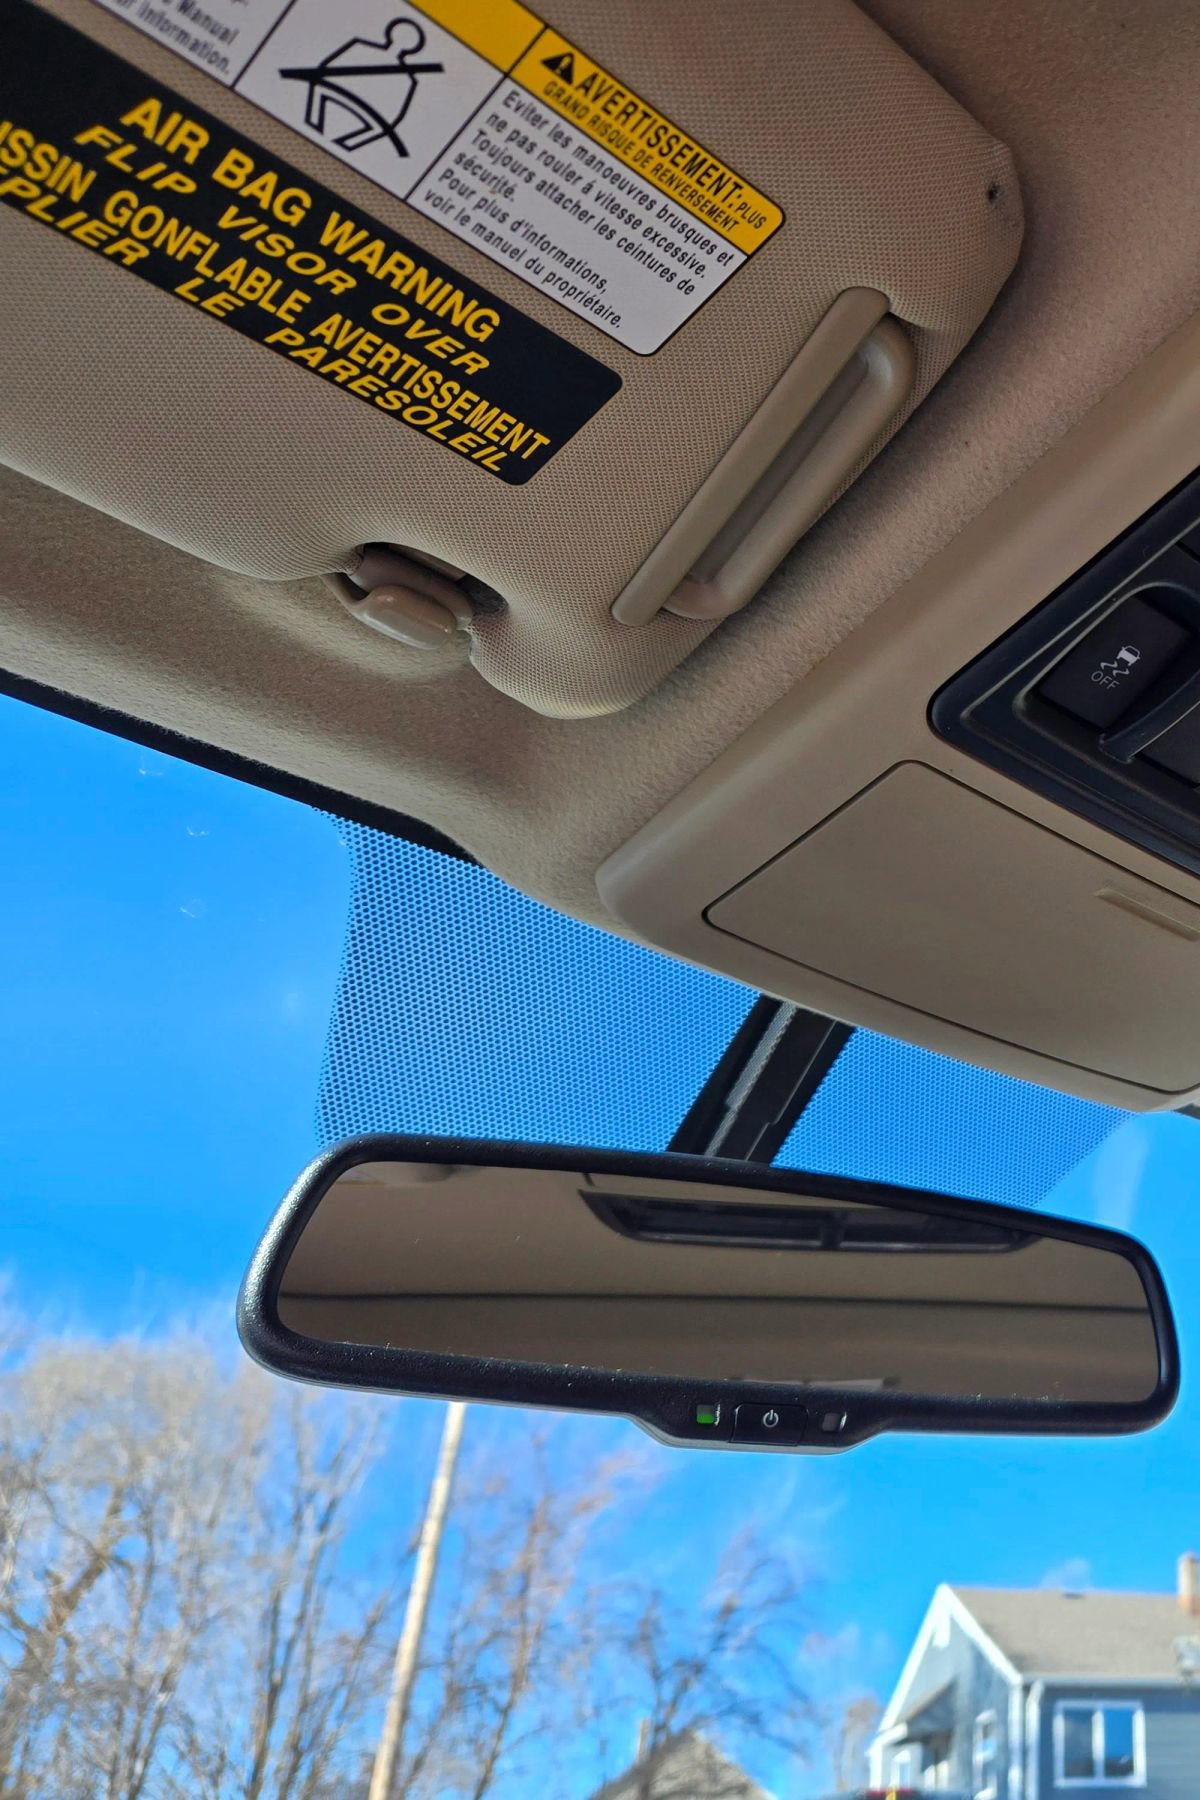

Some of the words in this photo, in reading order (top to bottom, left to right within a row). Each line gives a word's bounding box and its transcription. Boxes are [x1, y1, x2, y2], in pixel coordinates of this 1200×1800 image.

[120, 99, 209, 164] AIR
[212, 149, 311, 226] BAG
[320, 212, 500, 342] WARNING
[439, 168, 476, 199] Pour
[473, 197, 509, 223] plus
[510, 220, 607, 294] d'informations,
[454, 153, 516, 201] sécurité.
[472, 129, 535, 183] Toujours
[536, 180, 595, 224] attacher
[594, 218, 616, 240] les
[617, 238, 677, 282] ceintures
[677, 279, 695, 295] de
[487, 114, 507, 132] ne
[505, 129, 537, 154] pas
[537, 150, 582, 184] rouler
[595, 191, 642, 229] vitesse
[643, 227, 705, 278] excessive.
[503, 90, 549, 129] Eviter
[548, 124, 572, 148] les
[573, 146, 656, 211] manoeuvres
[656, 204, 717, 255] brusques
[717, 252, 734, 266] et
[544, 81, 589, 119] GRAND
[588, 115, 635, 155] RISQUE
[633, 149, 653, 168] DE
[651, 163, 739, 231] RENVERSEMENT
[576, 73, 744, 208] AVERTISSEMENT:
[735, 202, 766, 229] PLUS
[0, 167, 149, 265] PLIER
[175, 278, 244, 316] LE
[265, 328, 511, 471] PARESOLEIL
[75, 126, 196, 193] FLIP
[218, 205, 356, 295] VISOR
[372, 304, 489, 375] OVER
[104, 191, 311, 323] GONFLABLE
[310, 313, 550, 459] AVERTISSEMENT
[425, 190, 455, 214] voir
[454, 208, 471, 226] le
[472, 223, 527, 261] manuel
[525, 258, 544, 275] du
[542, 272, 621, 328] propriétaire.
[1090, 670, 1121, 690] OFF
